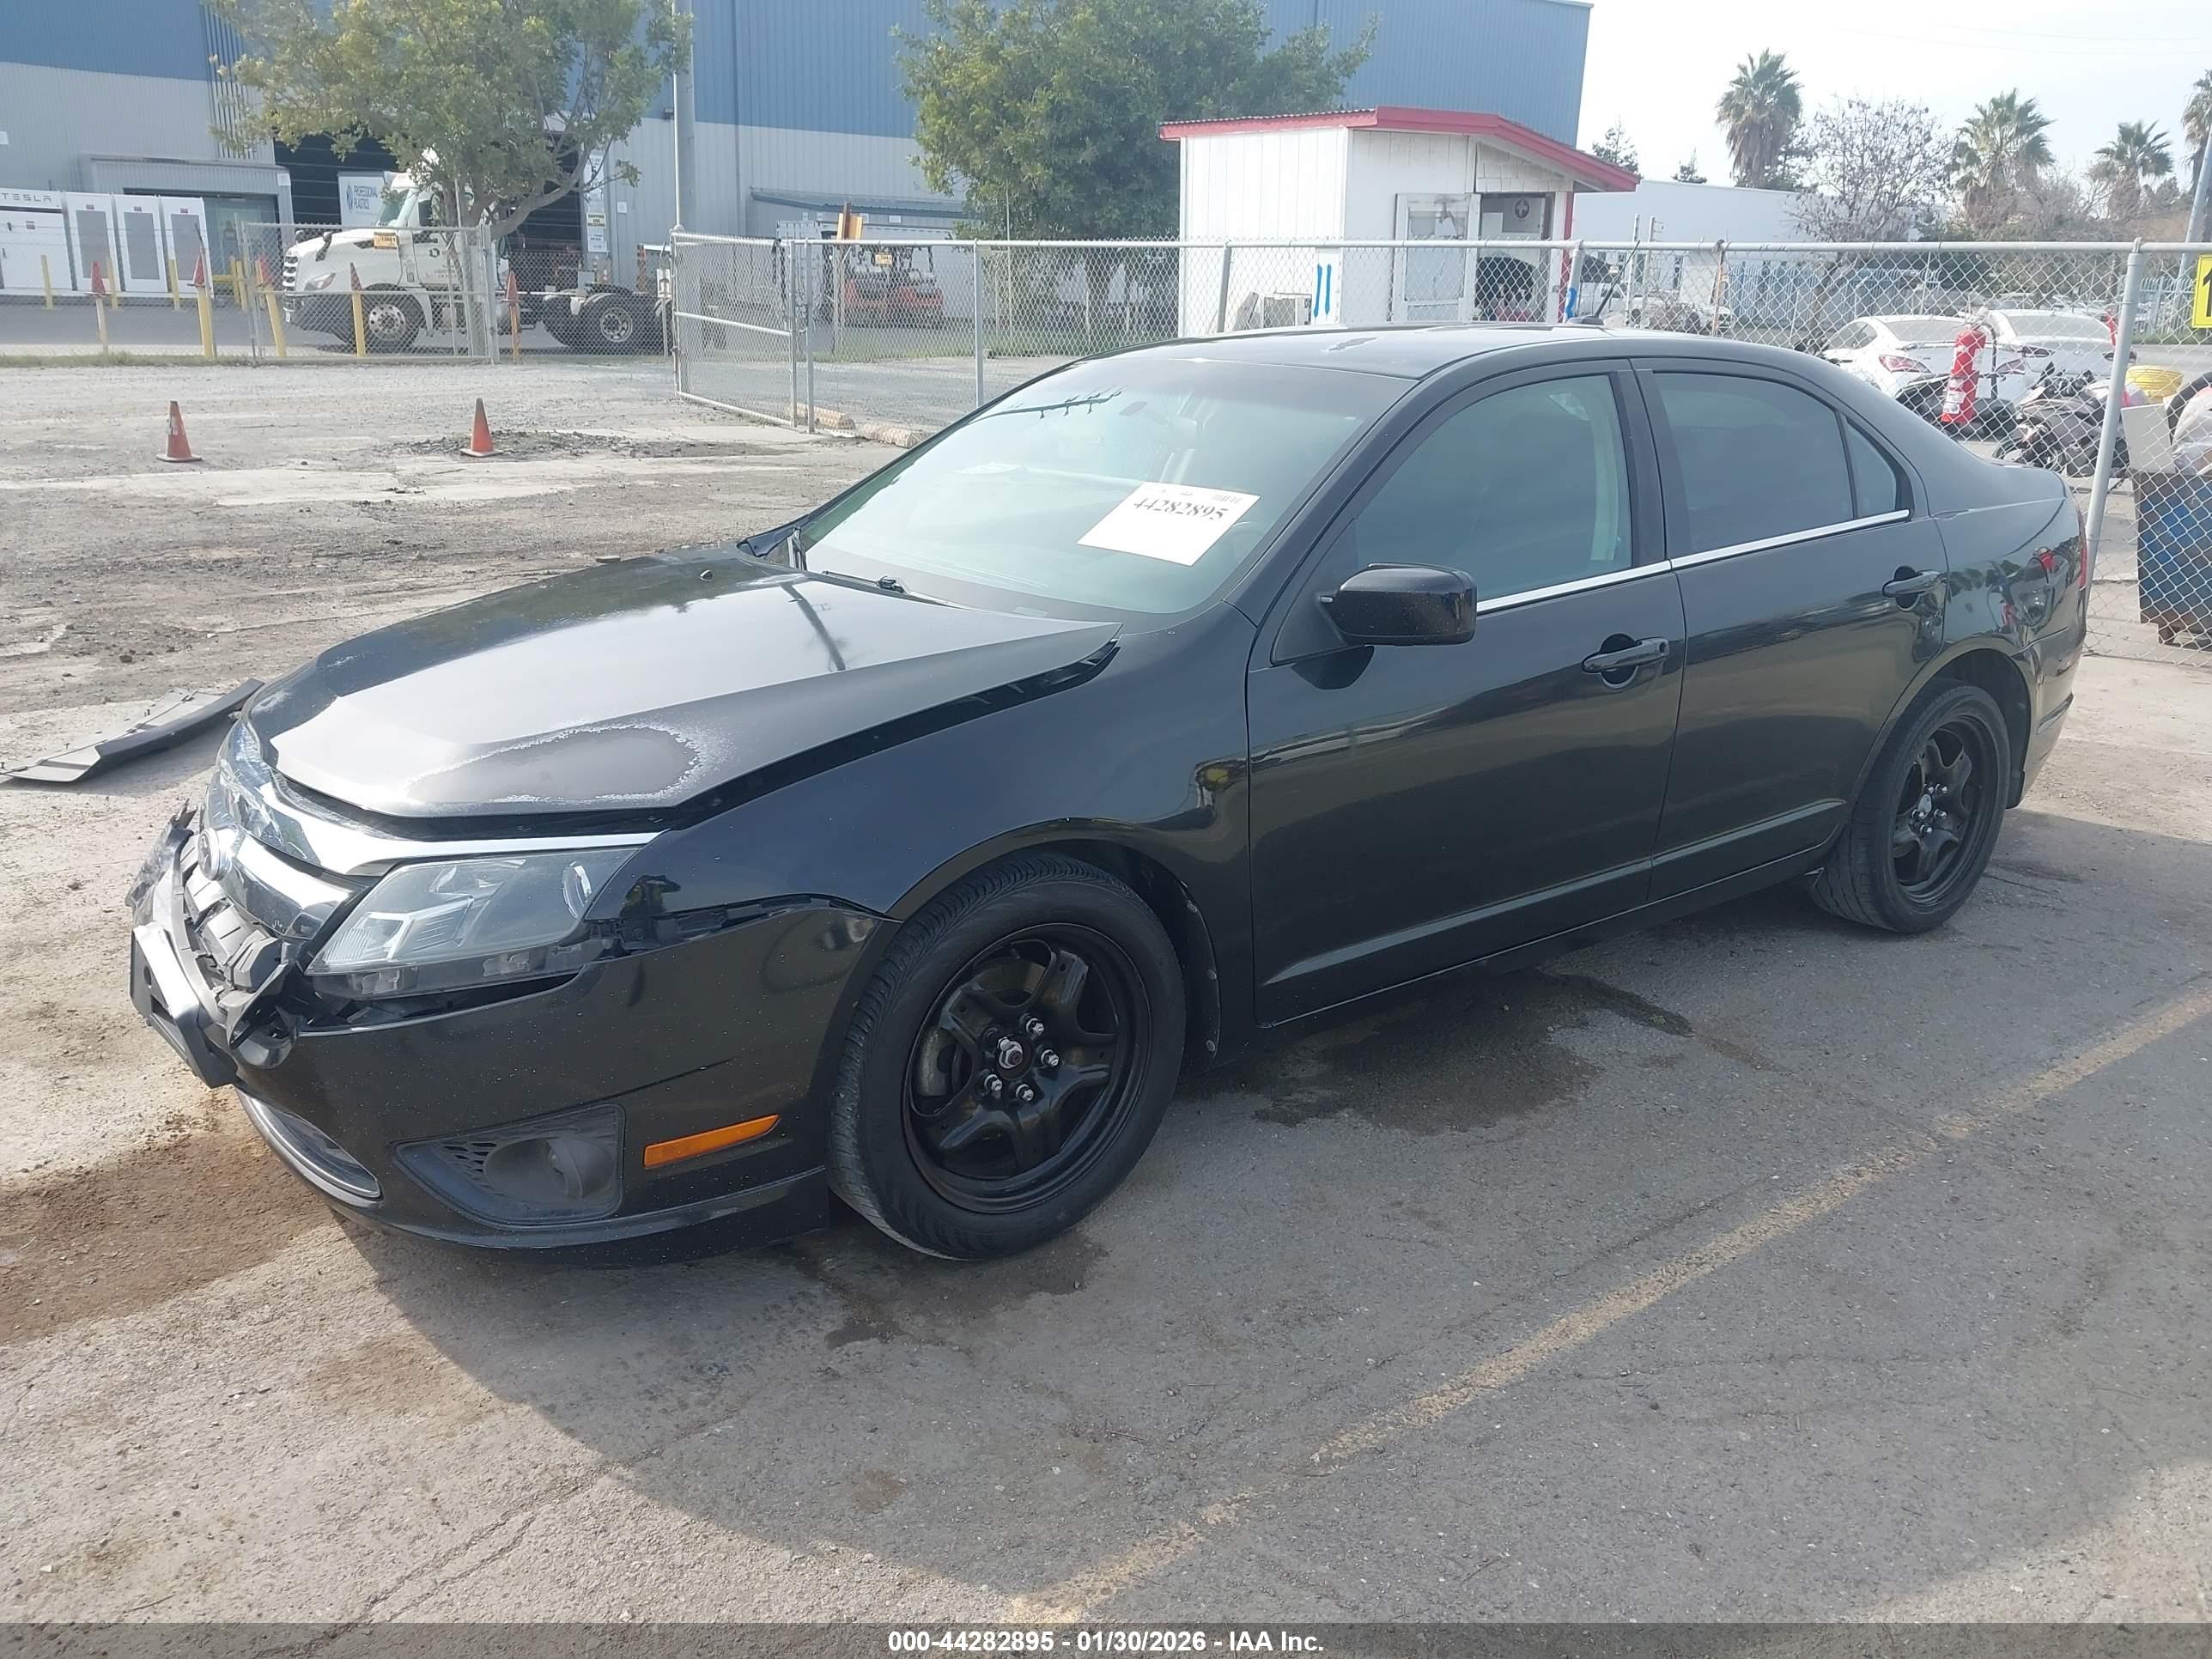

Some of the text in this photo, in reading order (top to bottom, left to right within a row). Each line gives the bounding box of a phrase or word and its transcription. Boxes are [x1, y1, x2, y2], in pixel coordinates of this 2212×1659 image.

[0, 192, 52, 203] TESLA
[353, 185, 378, 198] PROFESSIONAL
[1133, 496, 1229, 520] 44282895
